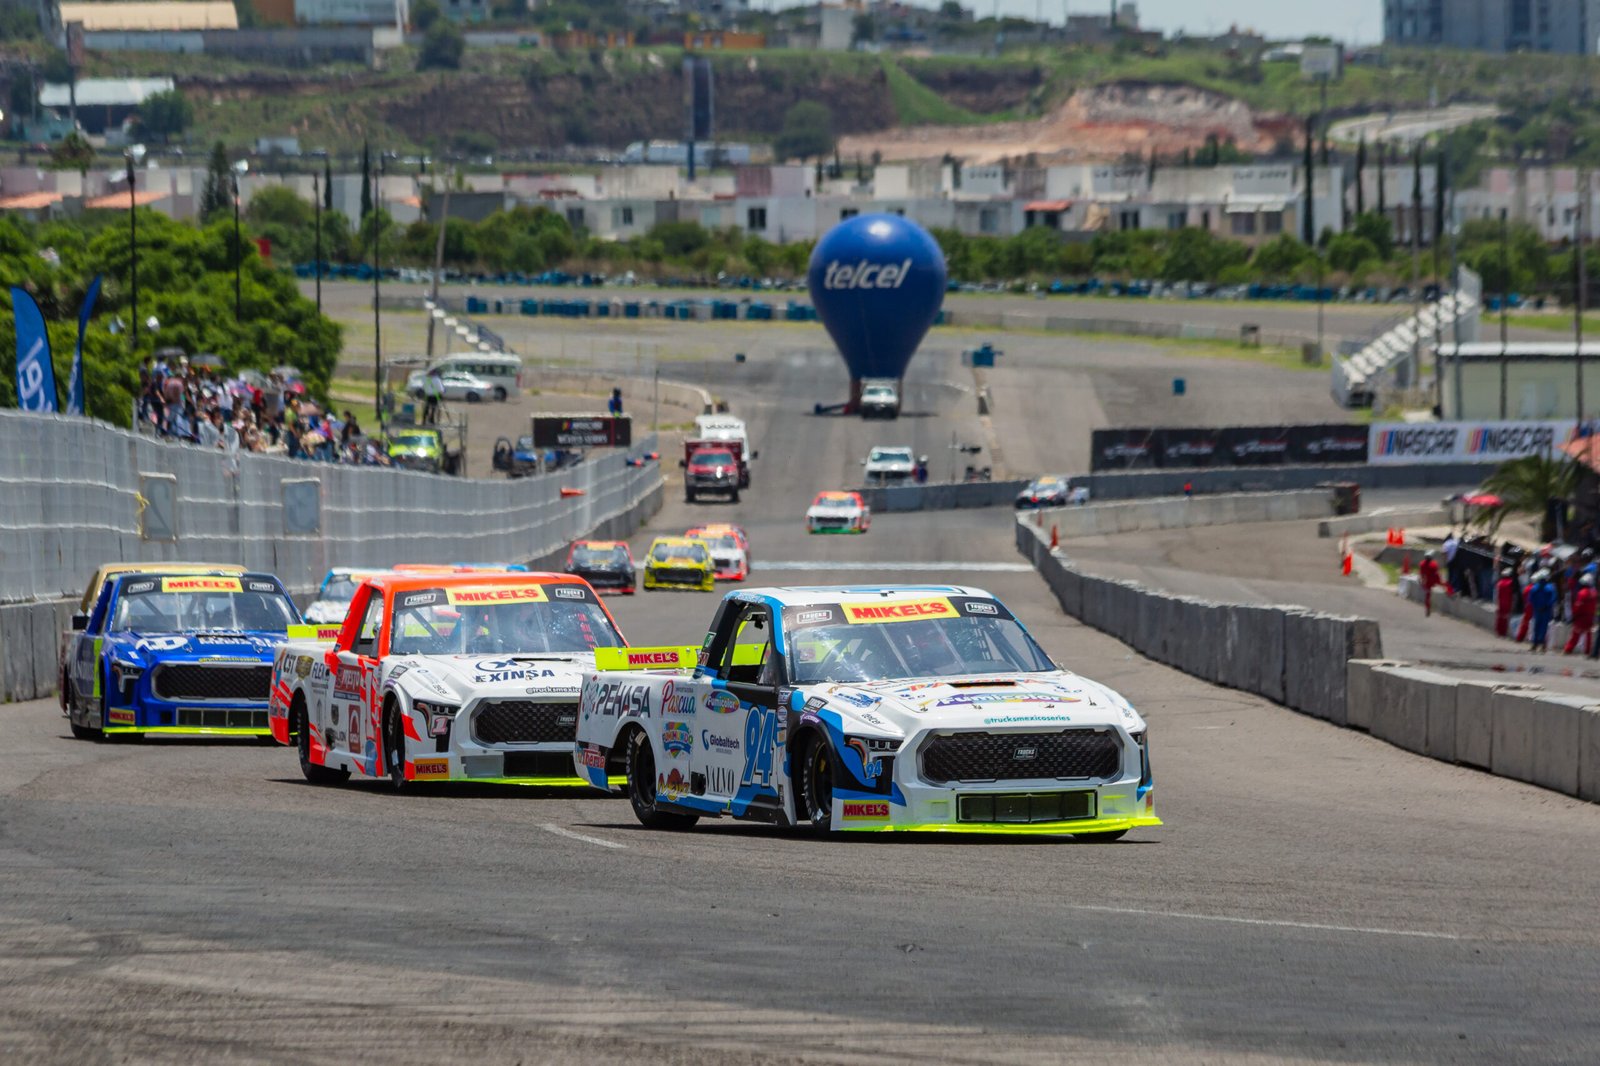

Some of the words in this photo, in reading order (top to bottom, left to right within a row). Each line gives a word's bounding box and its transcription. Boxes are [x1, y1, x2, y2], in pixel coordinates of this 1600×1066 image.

[824, 258, 912, 289] telcel
[1394, 428, 1458, 456] NASCAR
[1486, 427, 1554, 456] NASCAR
[454, 588, 539, 601] MIKEL'S
[850, 602, 949, 619] MIKEL'S
[318, 629, 341, 639] MIK
[628, 652, 680, 665] MIKEL'S
[475, 669, 555, 683] EXINSA
[983, 714, 1071, 725] @trucksmexicoseries
[709, 734, 740, 750] Globaltech
[741, 706, 777, 787] 94
[415, 763, 448, 775] MIKEL'S
[866, 759, 883, 780] 94
[842, 802, 890, 817] MIKEL'S
